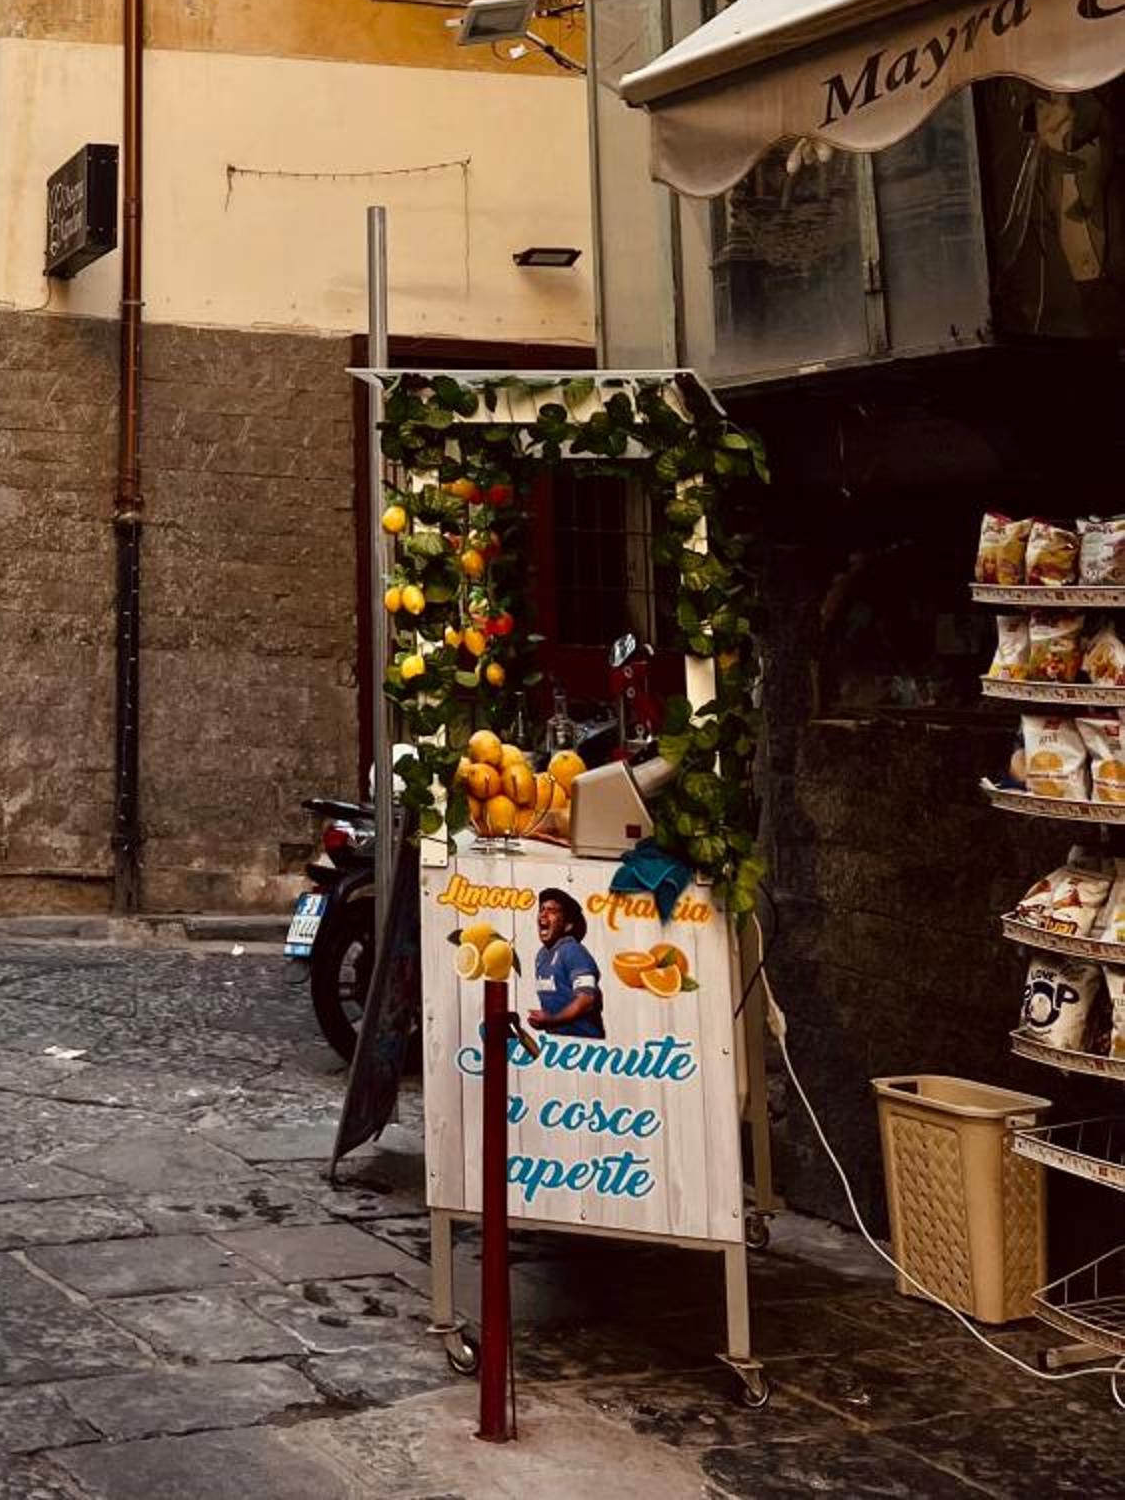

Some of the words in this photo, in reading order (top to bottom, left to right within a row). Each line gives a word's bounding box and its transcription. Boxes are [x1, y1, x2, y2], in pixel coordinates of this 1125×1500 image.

[438, 874, 536, 915] Limone
[539, 1099, 661, 1138] cosce
[507, 1151, 655, 1203] aperte
